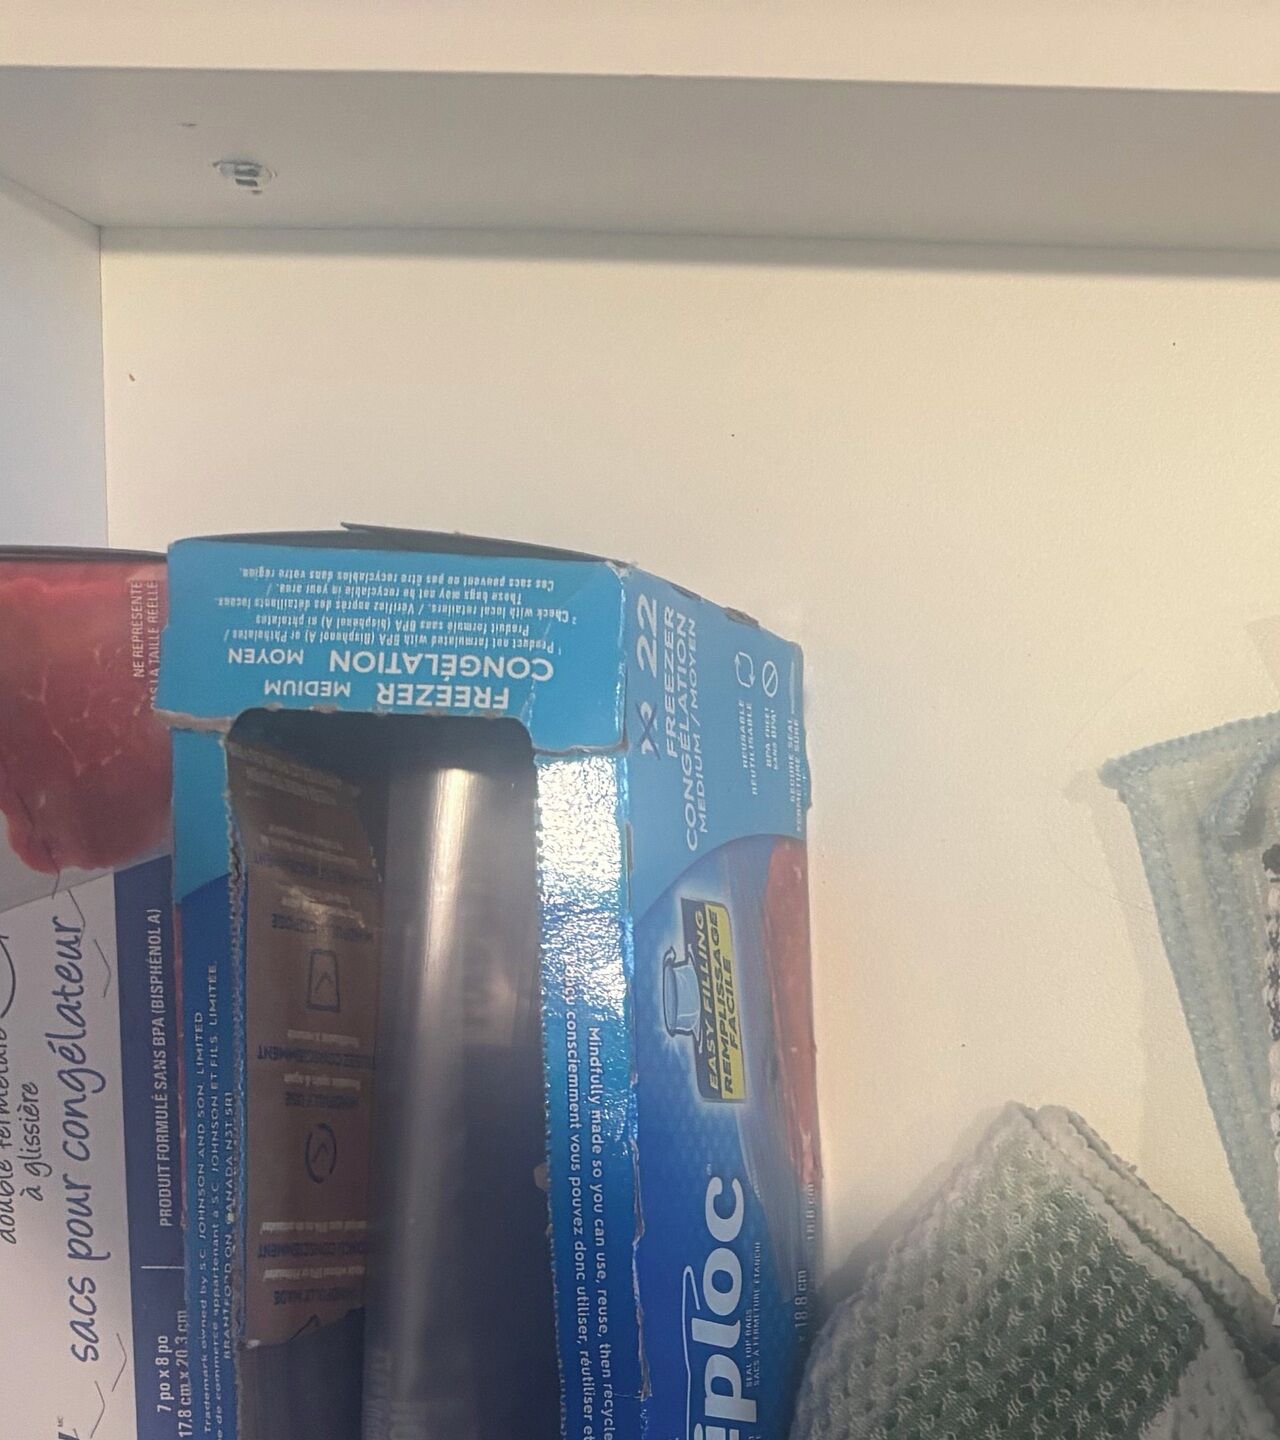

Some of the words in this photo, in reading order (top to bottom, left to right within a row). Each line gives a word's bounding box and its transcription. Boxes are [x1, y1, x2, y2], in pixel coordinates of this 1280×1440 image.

[481, 606, 506, 620] local
[491, 623, 529, 637] Produit
[509, 607, 533, 621] with
[538, 608, 570, 624] Check
[147, 627, 160, 664] TAILLE
[404, 634, 427, 648] with
[431, 634, 489, 651] formulated
[511, 638, 554, 654] Product
[636, 594, 657, 679] 22
[133, 660, 145, 678] NE
[228, 647, 304, 665] MOYEN
[330, 649, 554, 682] CONGÉLATION
[687, 617, 699, 709] MOYEN
[264, 679, 351, 699] MEDIUM
[376, 682, 509, 711] FREEZER
[662, 606, 681, 759] FREEZER
[675, 612, 698, 851] CONGÉLATION
[691, 734, 709, 833] MEDIUM
[146, 908, 163, 924] A)
[695, 910, 713, 1013] FILLING
[708, 908, 733, 1095] REMPLISSAGE
[722, 956, 739, 1050] FACILE
[44, 916, 106, 1160] congélateur
[151, 1017, 166, 1046] BPA
[194, 1011, 205, 1075] LIMITED
[152, 1049, 168, 1089] SANS
[565, 1011, 582, 1129] consciemment
[587, 1027, 603, 1104] Mindfully
[706, 1020, 719, 1090] EASY
[210, 1072, 218, 1090] ET
[16, 1081, 52, 1178] glissière
[151, 1093, 171, 1161] FORMULÉ
[197, 1124, 206, 1158] AND
[211, 1096, 219, 1172] JOHNSON
[591, 1109, 605, 1154] made
[569, 1133, 582, 1171] vous
[592, 1159, 603, 1177] so
[20, 1186, 43, 1201] à
[157, 1163, 174, 1226] PRODUIT
[197, 1163, 206, 1239] JOHNSON
[568, 1176, 584, 1235] pouvez
[589, 1183, 603, 1213] you
[61, 1174, 111, 1262] pour
[593, 1218, 605, 1246] can
[575, 1240, 589, 1281] donc
[593, 1251, 607, 1284] use,
[199, 1276, 209, 1294] by
[796, 1270, 808, 1291] cm
[67, 1276, 99, 1361] sacs
[199, 1300, 209, 1349] owned
[577, 1285, 592, 1344] utiliser,
[596, 1288, 609, 1337] reuse,
[154, 1356, 168, 1366] 8
[156, 1335, 173, 1354] po
[599, 1342, 612, 1378] then
[158, 1369, 170, 1379] x
[158, 1382, 175, 1400] po
[580, 1349, 597, 1420] réutiliser
[156, 1404, 172, 1413] 7
[179, 1383, 192, 1406] cm
[201, 1354, 212, 1434] Trademark
[214, 1405, 222, 1424] de
